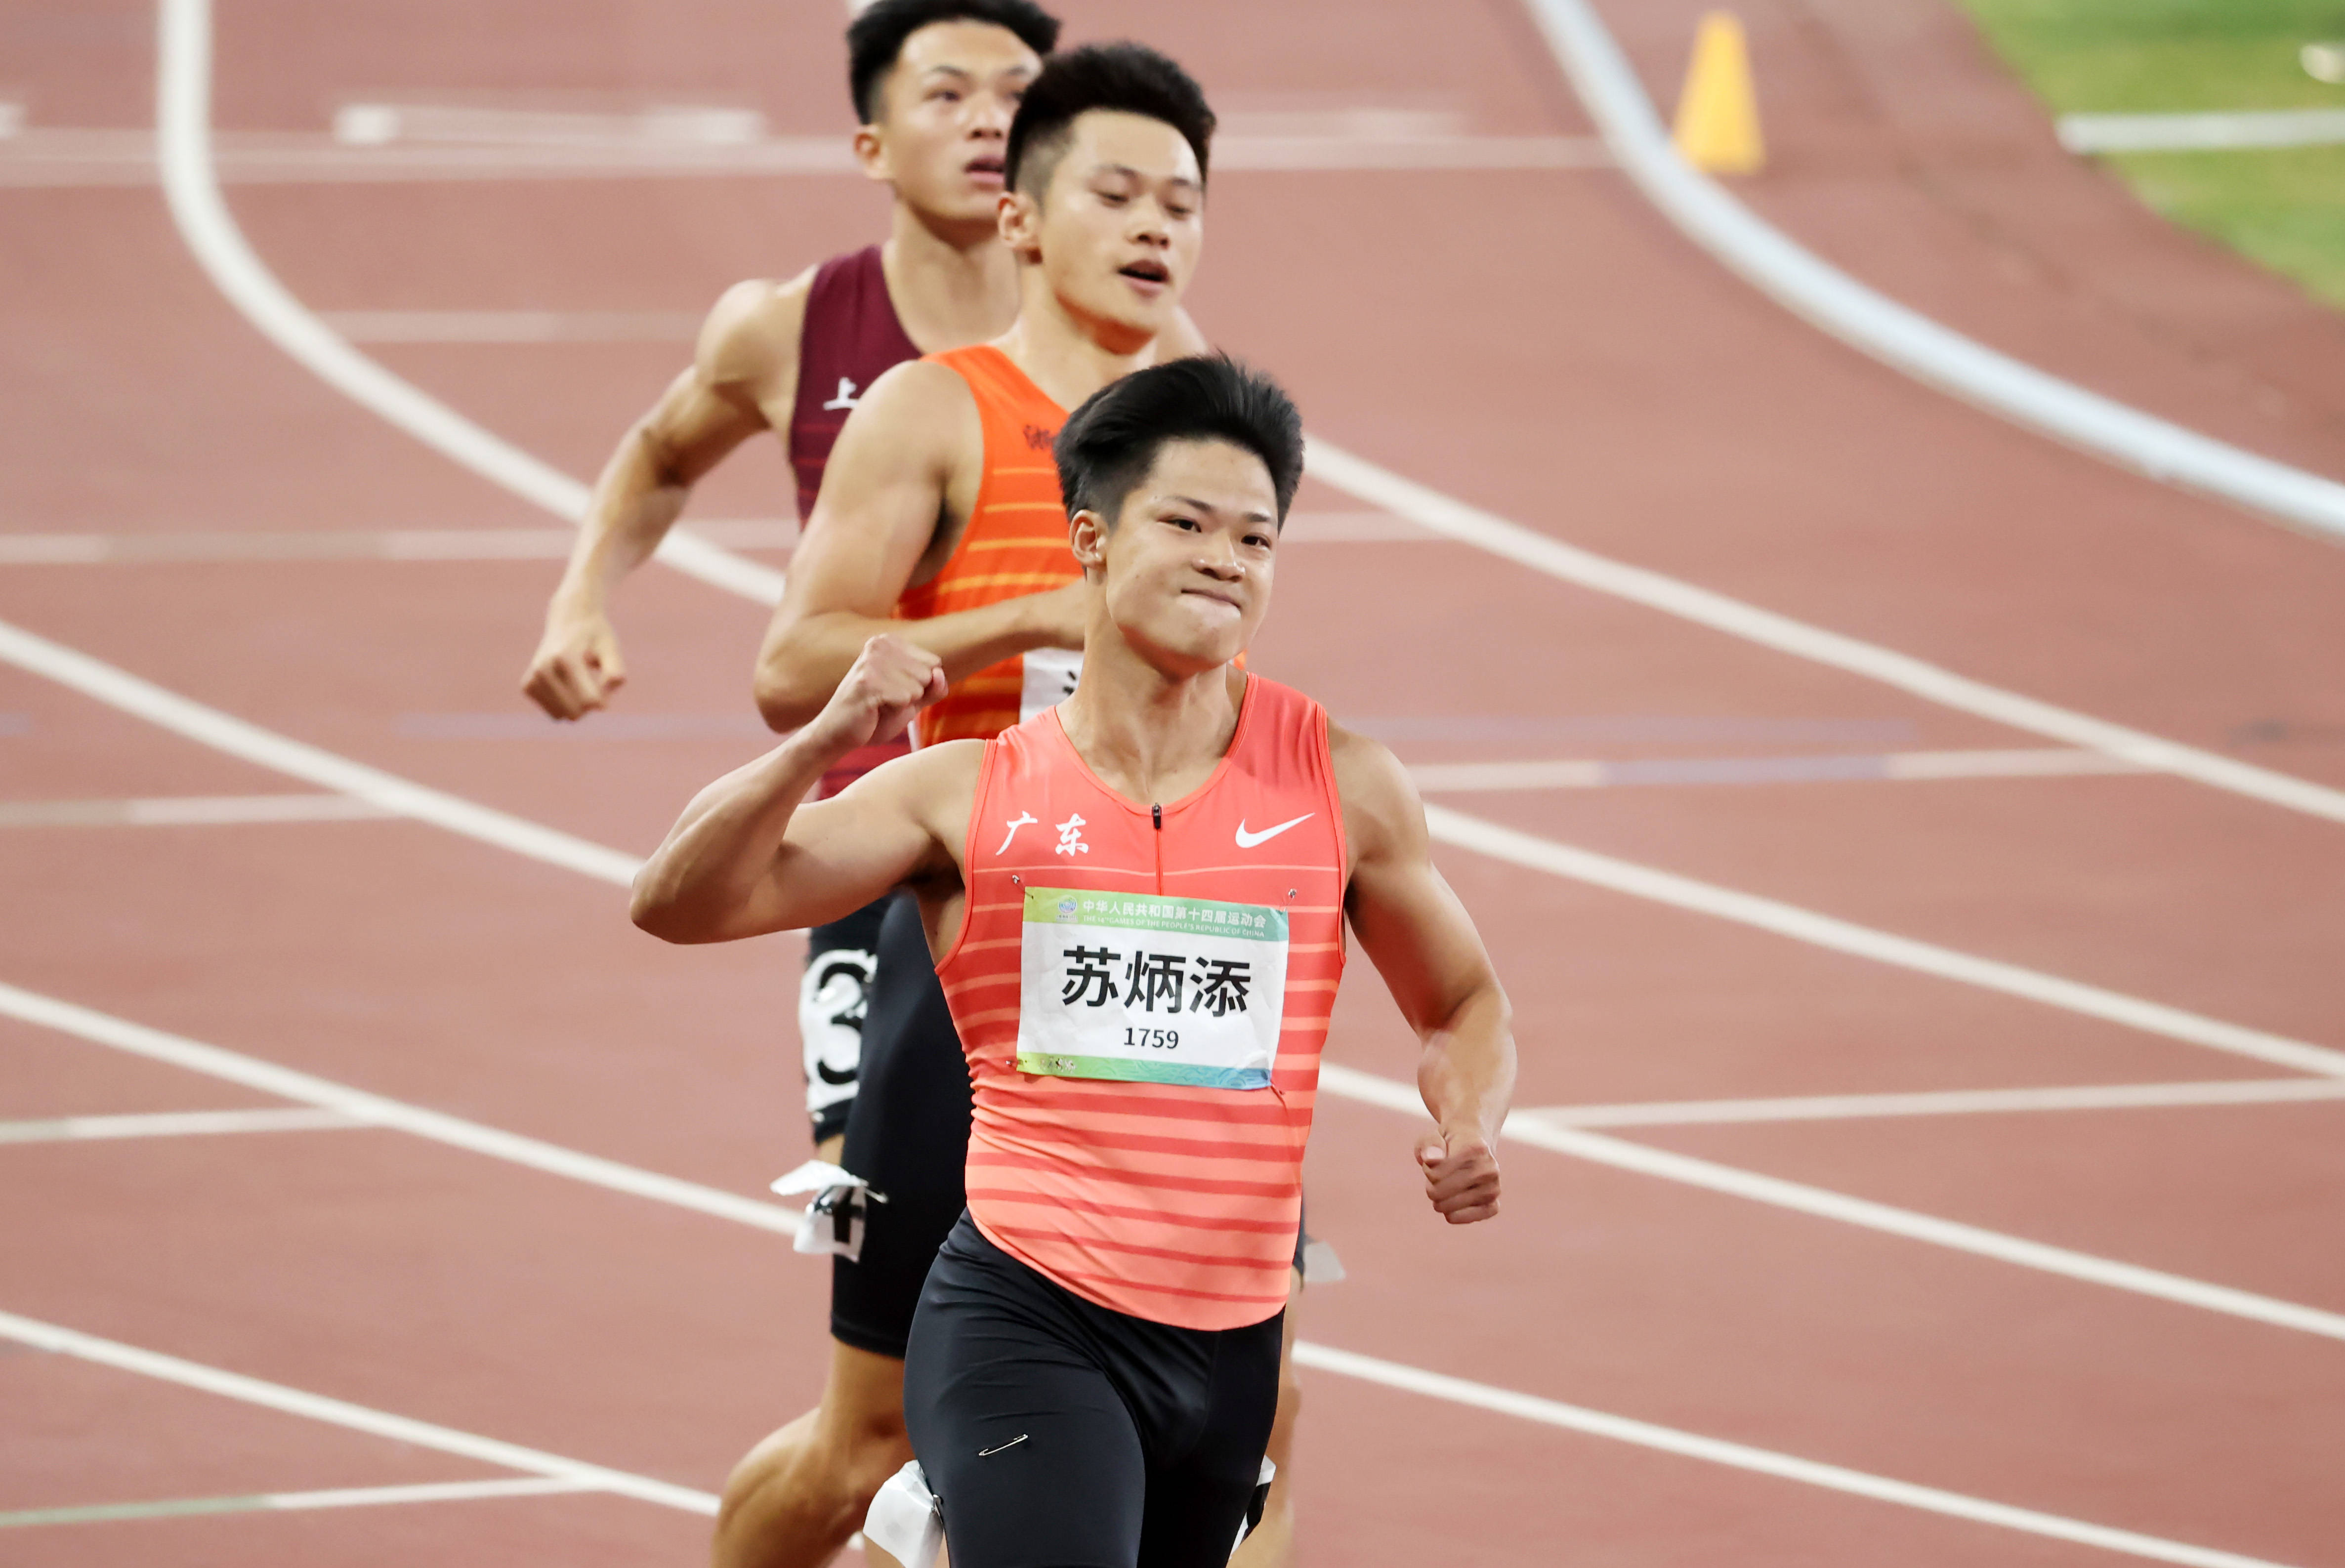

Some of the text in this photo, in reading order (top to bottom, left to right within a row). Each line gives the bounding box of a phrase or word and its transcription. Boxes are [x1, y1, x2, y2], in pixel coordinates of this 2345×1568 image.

[823, 376, 859, 411] 上
[995, 810, 1089, 857] 广东
[1083, 899, 1266, 928] 中华人民共和国第十四届运动会
[1161, 920, 1194, 930] PEOPLE'S
[1196, 924, 1229, 934] REPUBLIC
[1242, 928, 1264, 937] CHINA
[1062, 945, 1251, 1017] 苏炳添
[817, 962, 868, 1085] 3
[1124, 1028, 1179, 1049] 1759
